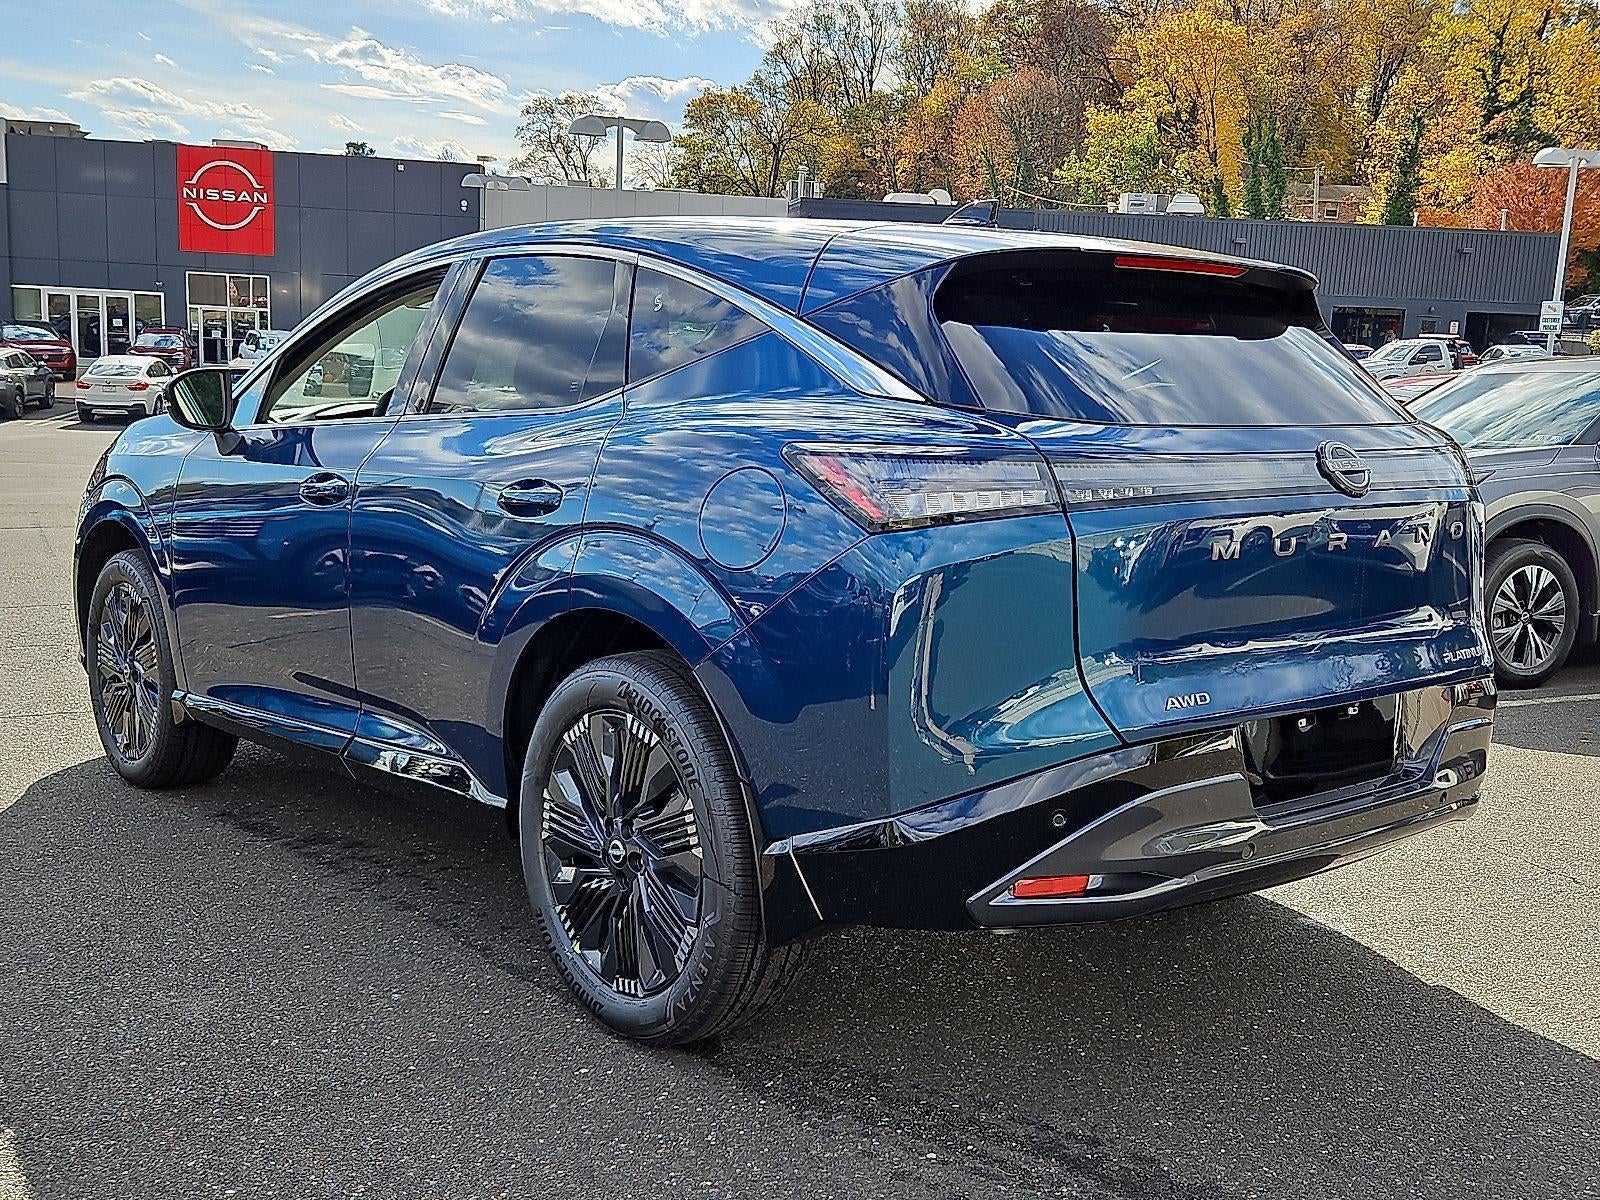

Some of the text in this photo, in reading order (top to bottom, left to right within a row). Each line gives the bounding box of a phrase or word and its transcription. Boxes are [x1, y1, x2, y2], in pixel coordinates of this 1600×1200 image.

[182, 187, 268, 203] NISSAN
[1211, 521, 1465, 561] MURANO
[1165, 692, 1211, 711] AWD
[617, 681, 698, 791] BRIDGESTONE
[676, 933, 715, 1012] ALENZA
